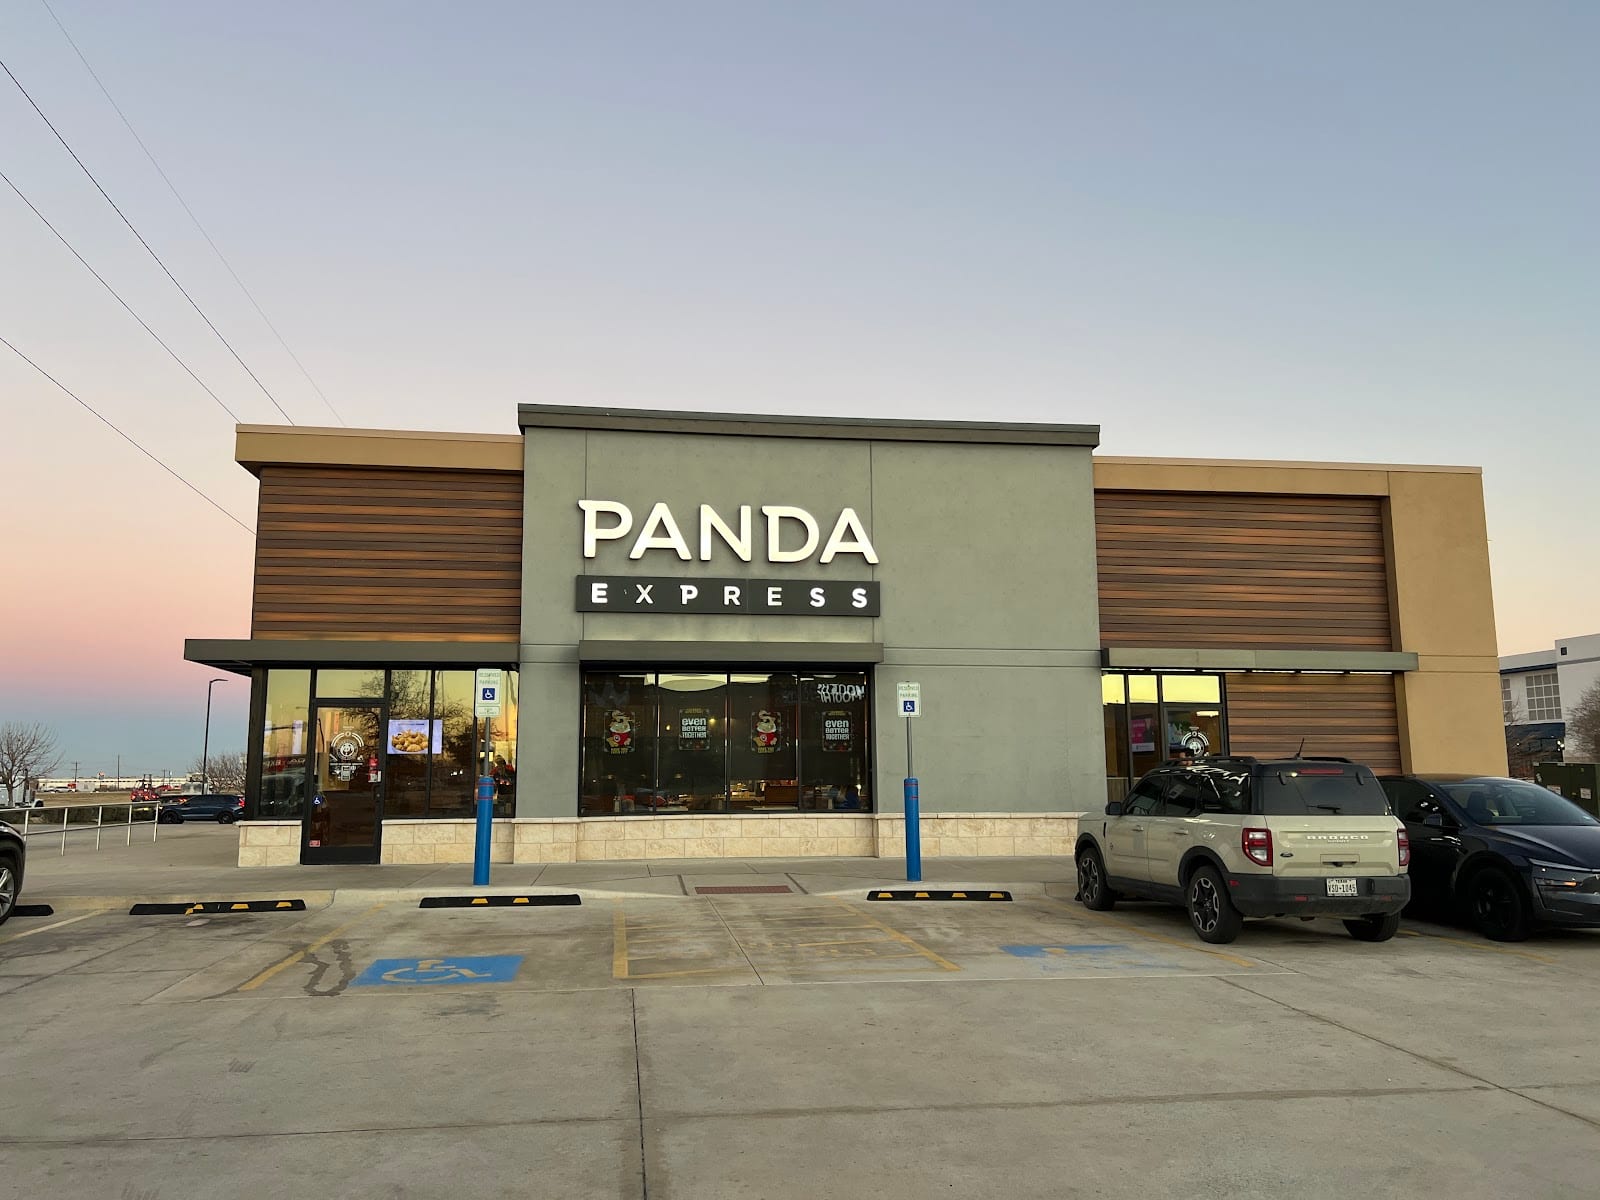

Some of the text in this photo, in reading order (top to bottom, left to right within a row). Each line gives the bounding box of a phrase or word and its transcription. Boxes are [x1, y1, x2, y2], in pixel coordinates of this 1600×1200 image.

[578, 499, 880, 565] PANDA
[590, 582, 868, 609] EXPRESS
[681, 717, 707, 725] even
